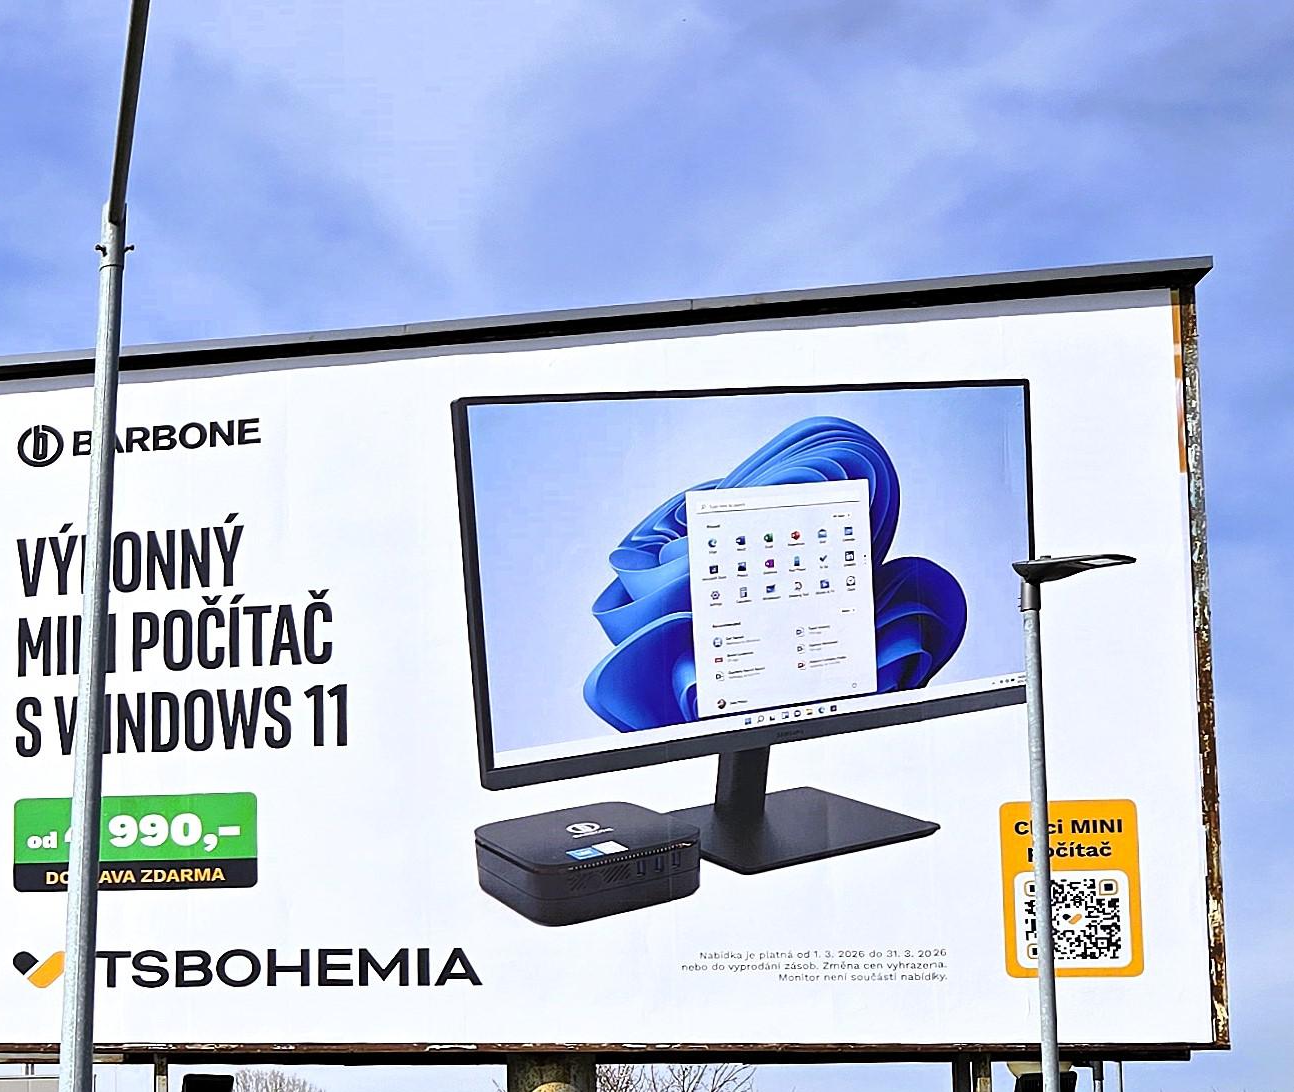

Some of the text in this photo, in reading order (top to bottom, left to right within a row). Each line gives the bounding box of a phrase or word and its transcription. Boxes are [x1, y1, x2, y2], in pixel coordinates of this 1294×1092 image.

[16, 512, 245, 598] VÝONNÝ
[17, 588, 333, 678] MII POČÍTAČ
[15, 696, 42, 758] S
[303, 683, 348, 747] 11
[1014, 818, 1123, 835] Cci MINI
[26, 830, 58, 850] od
[45, 867, 226, 885] DOAVA ZDARMA
[699, 951, 743, 960] Nabídka
[744, 950, 756, 961] je
[759, 950, 794, 961] platná
[796, 950, 811, 959] od
[824, 950, 834, 958] 3.
[838, 950, 866, 958] 2026
[868, 950, 883, 958] do
[886, 950, 901, 958] 31.
[903, 949, 914, 958] 3.
[917, 949, 947, 958] 2026
[96, 947, 484, 989] TSBOHEMIA
[681, 963, 708, 971] nebo
[711, 962, 725, 971] do
[728, 962, 781, 973] vyprodání
[784, 961, 819, 970] zásob.
[822, 961, 860, 970] Změna
[886, 961, 947, 972] vyhrazena.
[778, 972, 948, 983] Monitor není součástí nabídky.
